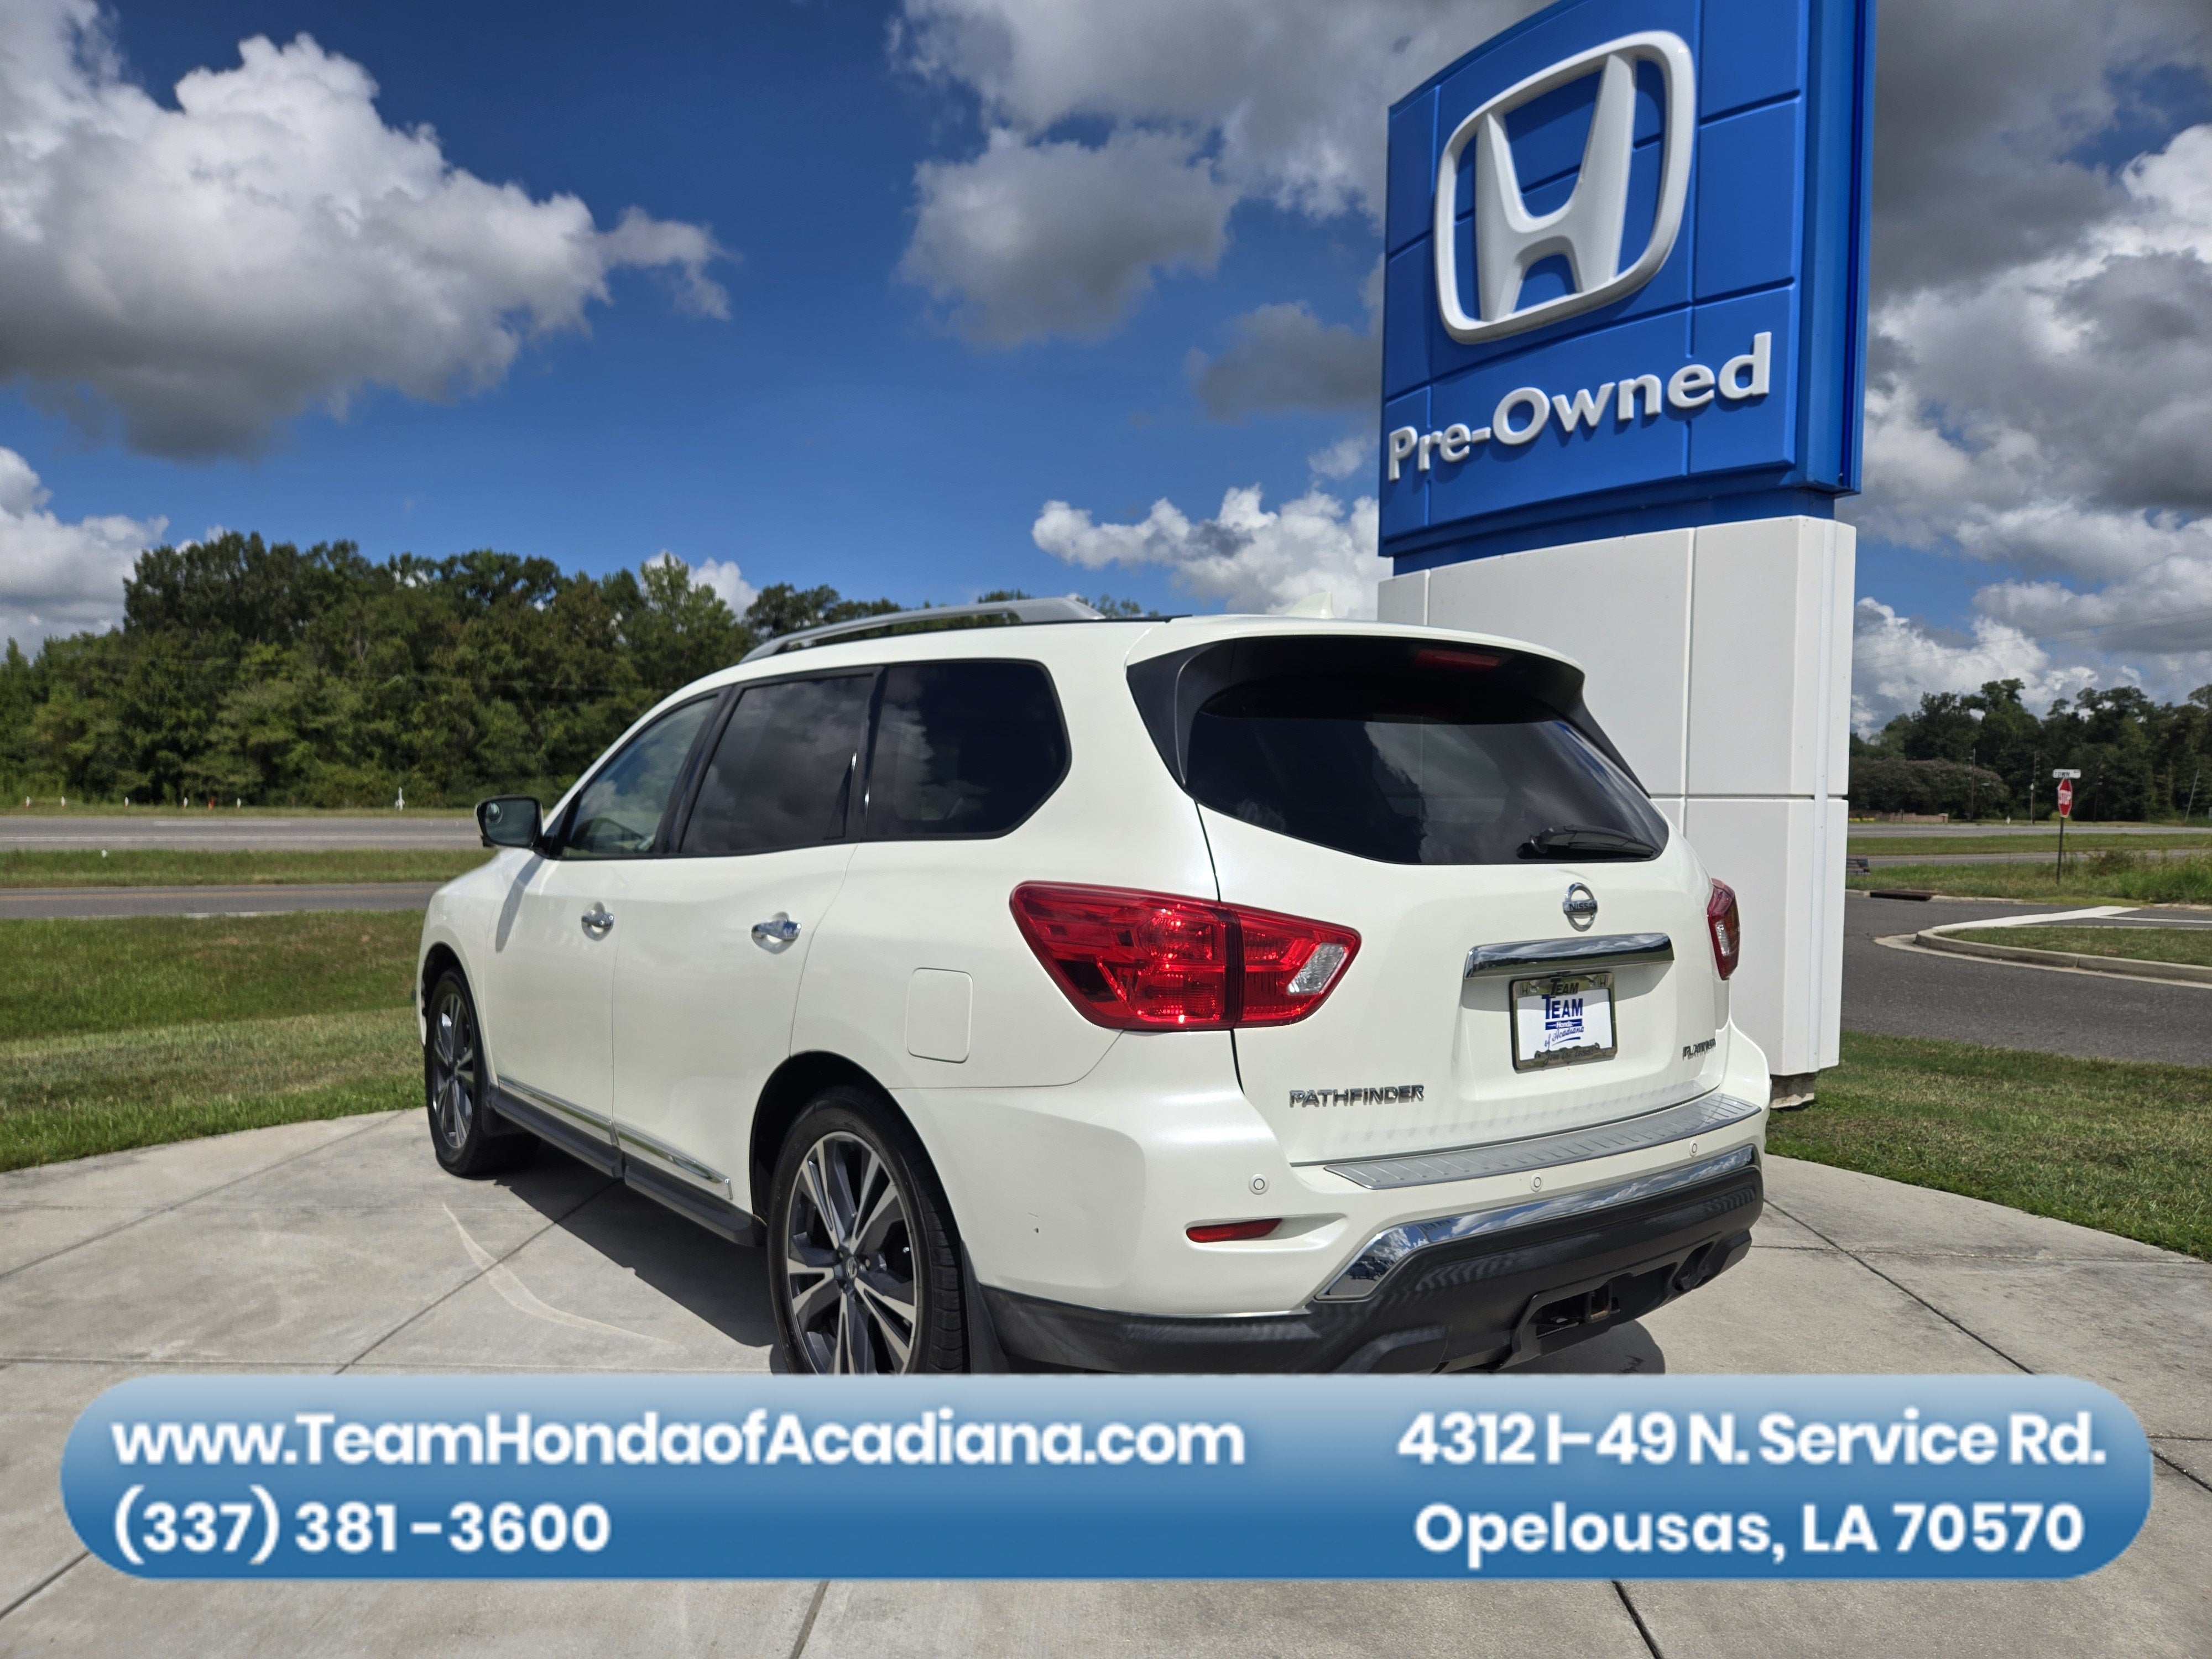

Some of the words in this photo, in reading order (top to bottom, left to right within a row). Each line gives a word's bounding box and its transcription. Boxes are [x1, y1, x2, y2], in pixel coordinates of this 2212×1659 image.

[1388, 331, 1771, 481] Pre-Owned
[1569, 901, 1597, 911] NISSAN
[1550, 977, 1579, 996] TEAM
[1541, 994, 1583, 1020] TEAM
[1552, 1026, 1585, 1041] Acadiana
[1289, 1084, 1425, 1107] PATHFINDER
